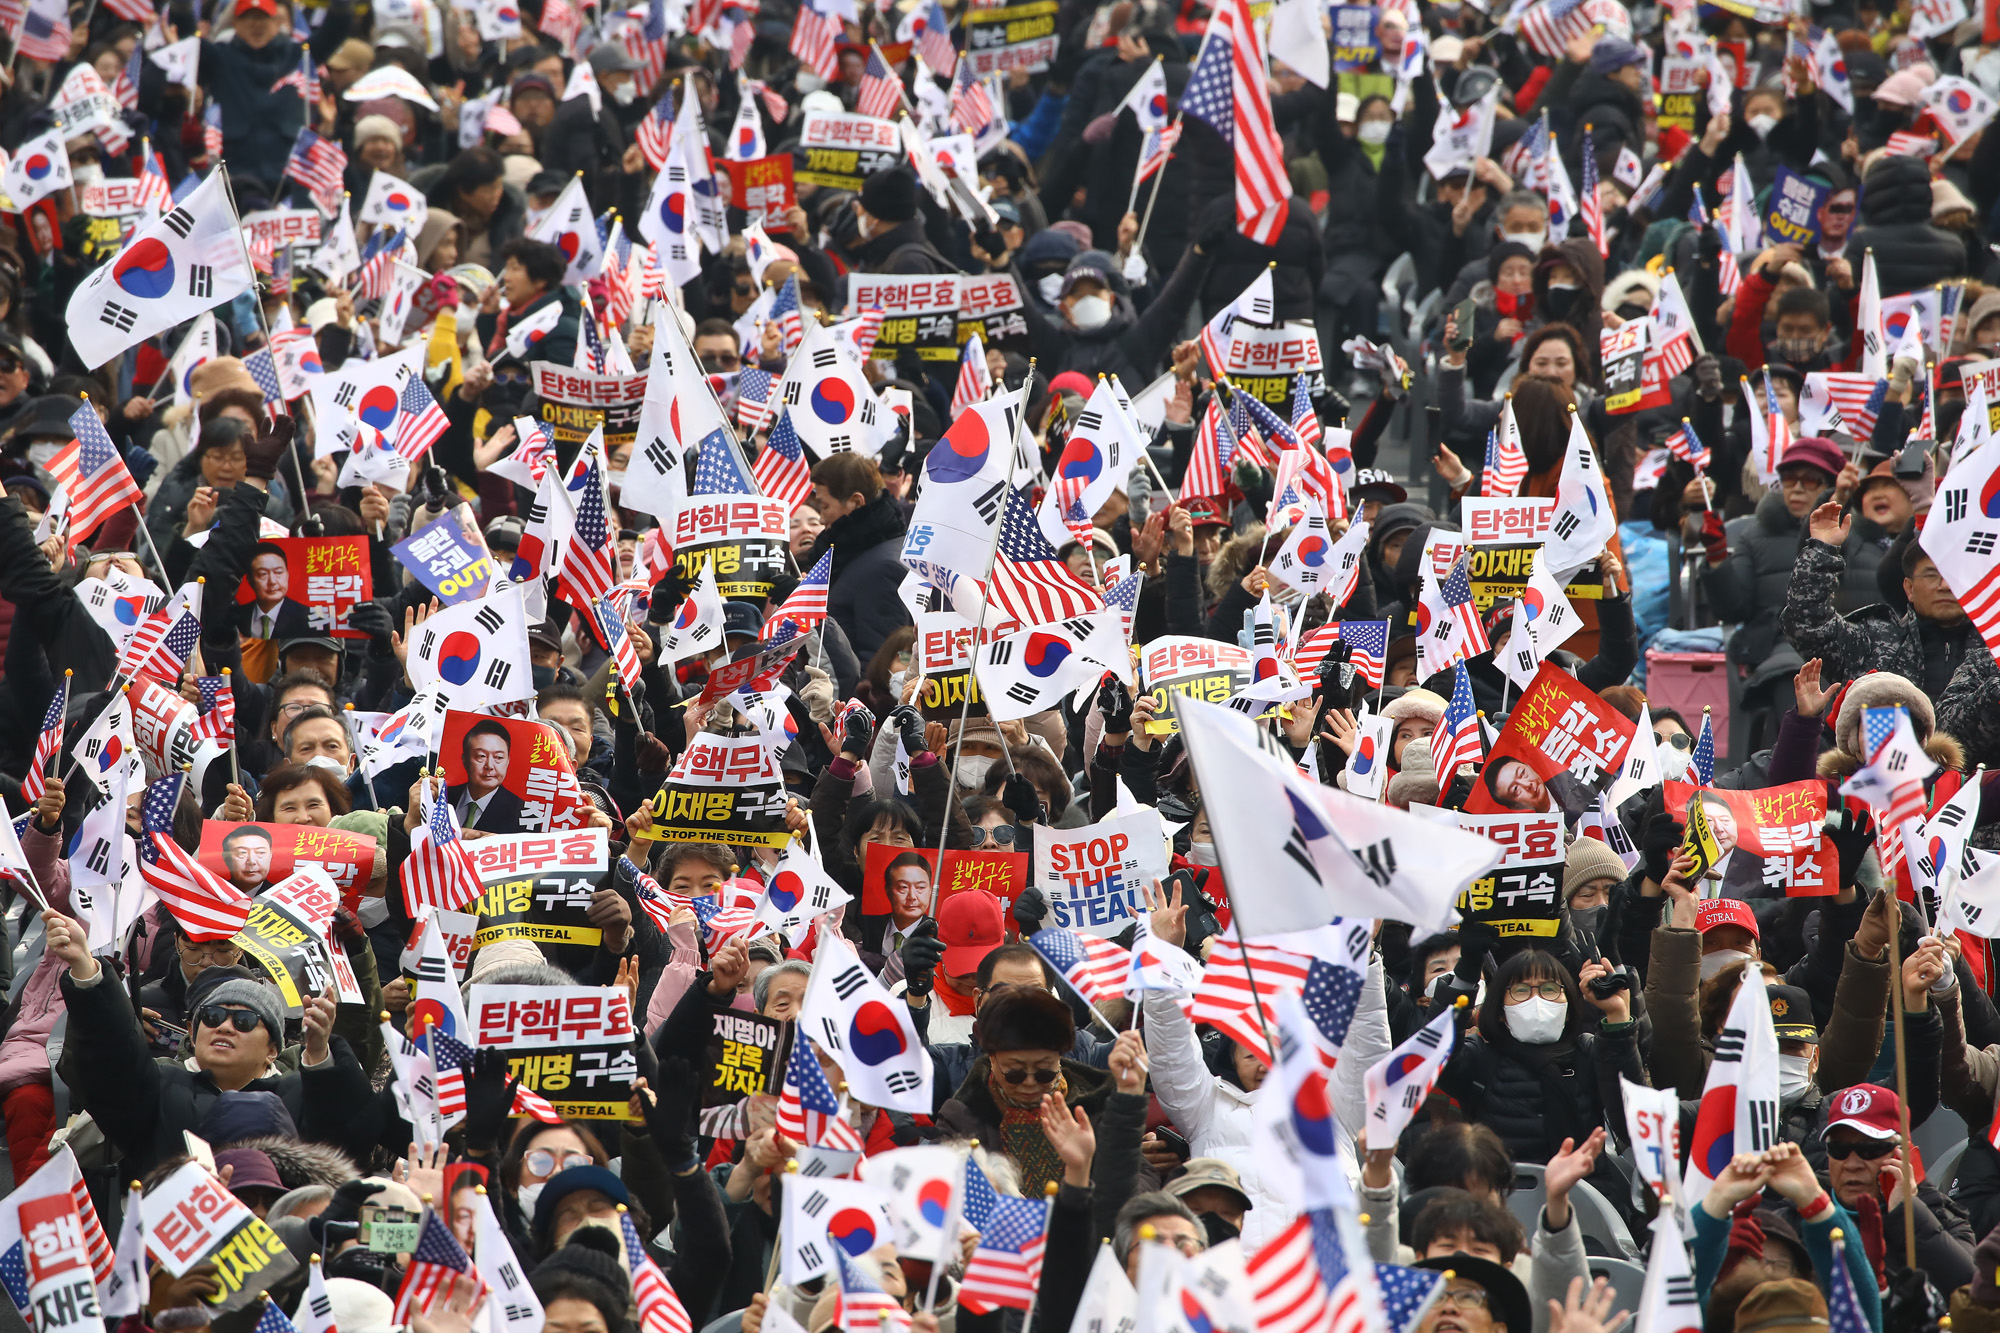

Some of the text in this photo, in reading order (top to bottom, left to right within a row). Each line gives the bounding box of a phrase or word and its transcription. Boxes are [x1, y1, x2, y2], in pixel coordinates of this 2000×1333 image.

[808, 121, 895, 146] 탄핵무효
[1769, 211, 1815, 245] OUT!
[856, 280, 955, 313] 탄핵무효
[875, 318, 918, 344] 재명
[917, 315, 954, 340] 구속
[986, 312, 1028, 340] 구속
[1228, 338, 1320, 371] 탄핵무효
[541, 371, 649, 404] 탄핵무효
[1605, 357, 1636, 389] 구속
[542, 402, 606, 429] 이재명
[557, 430, 584, 439] STOP
[676, 503, 786, 545] 탄핵무효
[306, 543, 360, 574] 불법구속
[407, 525, 455, 563] 음란
[428, 544, 473, 577] 수괴
[438, 557, 493, 597] OUT!
[676, 544, 786, 580] 이재명 구속
[307, 574, 363, 604] 즉각
[719, 585, 738, 594] THE
[1148, 643, 1250, 682] 탄핵무
[924, 674, 979, 708] 이재
[1152, 674, 1231, 714] 이재명
[1514, 680, 1570, 747] 불법구속
[1539, 700, 1600, 765] 즉각
[1567, 727, 1628, 786] 취소
[525, 766, 584, 806] 즉각
[518, 799, 582, 833] 취소
[651, 788, 789, 821] 이재명 구속
[1752, 788, 1817, 825] 불법구속
[293, 832, 360, 858] 불법구속
[661, 830, 770, 845] STOP THE STEAL
[1051, 833, 1129, 872] STOP
[1758, 821, 1822, 853] 즉각
[951, 859, 1013, 892] 불법구속
[1063, 864, 1125, 899] THE
[1761, 854, 1824, 888] 취소
[463, 878, 596, 918] 재명 구속
[1497, 872, 1556, 906] 구속
[1053, 889, 1147, 928] STEAL
[1698, 899, 1741, 914] STOP THE
[1705, 912, 1738, 925] STEAL
[246, 903, 309, 948] 이재명
[476, 926, 572, 944] STOP THE STEAL
[259, 953, 286, 981] STEAL
[479, 994, 632, 1045] 탄핵무효
[713, 1014, 776, 1050] 재명아
[508, 1049, 638, 1092] 재명 구속
[722, 1040, 763, 1073] 감옥
[713, 1063, 766, 1097] 가자!
[566, 1105, 616, 1116] STEAL
